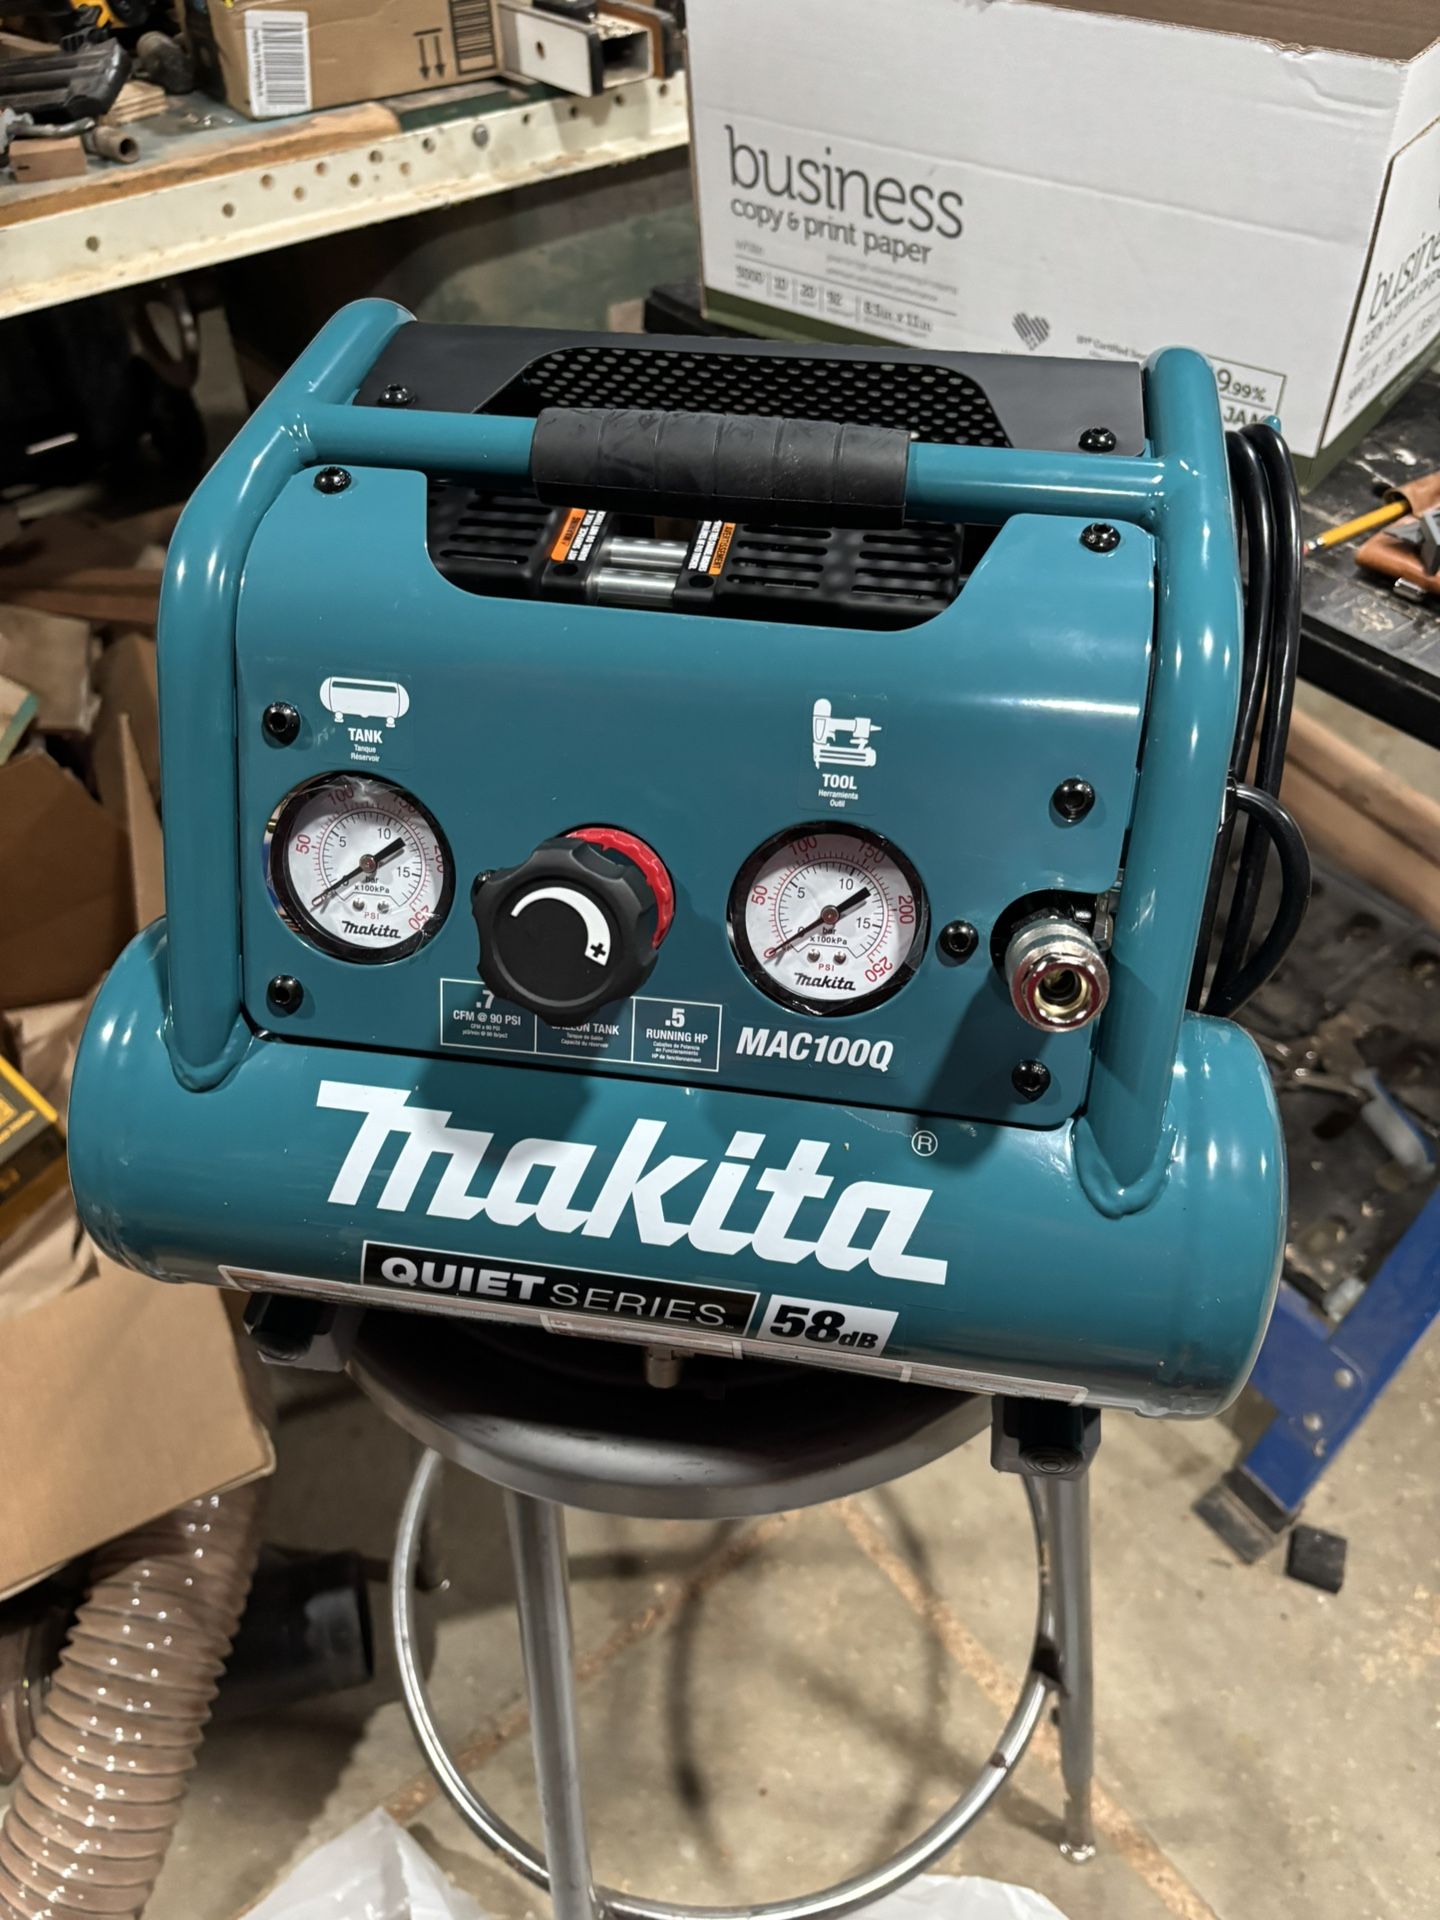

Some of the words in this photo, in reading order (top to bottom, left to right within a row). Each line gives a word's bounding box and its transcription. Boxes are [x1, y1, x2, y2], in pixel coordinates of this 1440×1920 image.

[724, 124, 964, 239] business
[731, 198, 783, 232] copy
[787, 211, 799, 231] &
[803, 214, 857, 246] print
[863, 231, 932, 264] paper
[348, 727, 383, 744] TANK
[822, 773, 858, 790] TOOL
[328, 788, 355, 805] 100
[339, 836, 347, 848] 5
[377, 828, 391, 840] 10
[296, 834, 311, 855] 50
[789, 836, 818, 855] 100
[858, 840, 887, 864] 150
[396, 866, 411, 879] 15
[797, 887, 806, 899] 5
[839, 878, 854, 891] 10
[751, 886, 768, 906] 50
[364, 912, 380, 920] PSI
[898, 895, 914, 925] 200
[856, 917, 871, 929] 15
[818, 963, 835, 972] PSI
[865, 956, 893, 983] 250
[476, 989, 495, 1009] .7
[453, 1009, 475, 1021] CFM
[477, 1012, 488, 1023] @
[490, 1013, 502, 1024] 90
[505, 1015, 521, 1026] PSI
[665, 1007, 685, 1028] .5
[593, 1022, 620, 1036] TANK
[646, 1028, 692, 1042] RUNNING
[694, 1033, 708, 1044] HP
[736, 1026, 894, 1073] MAC100Q
[381, 1256, 546, 1301] QUIET
[770, 1304, 879, 1349] 58dB
